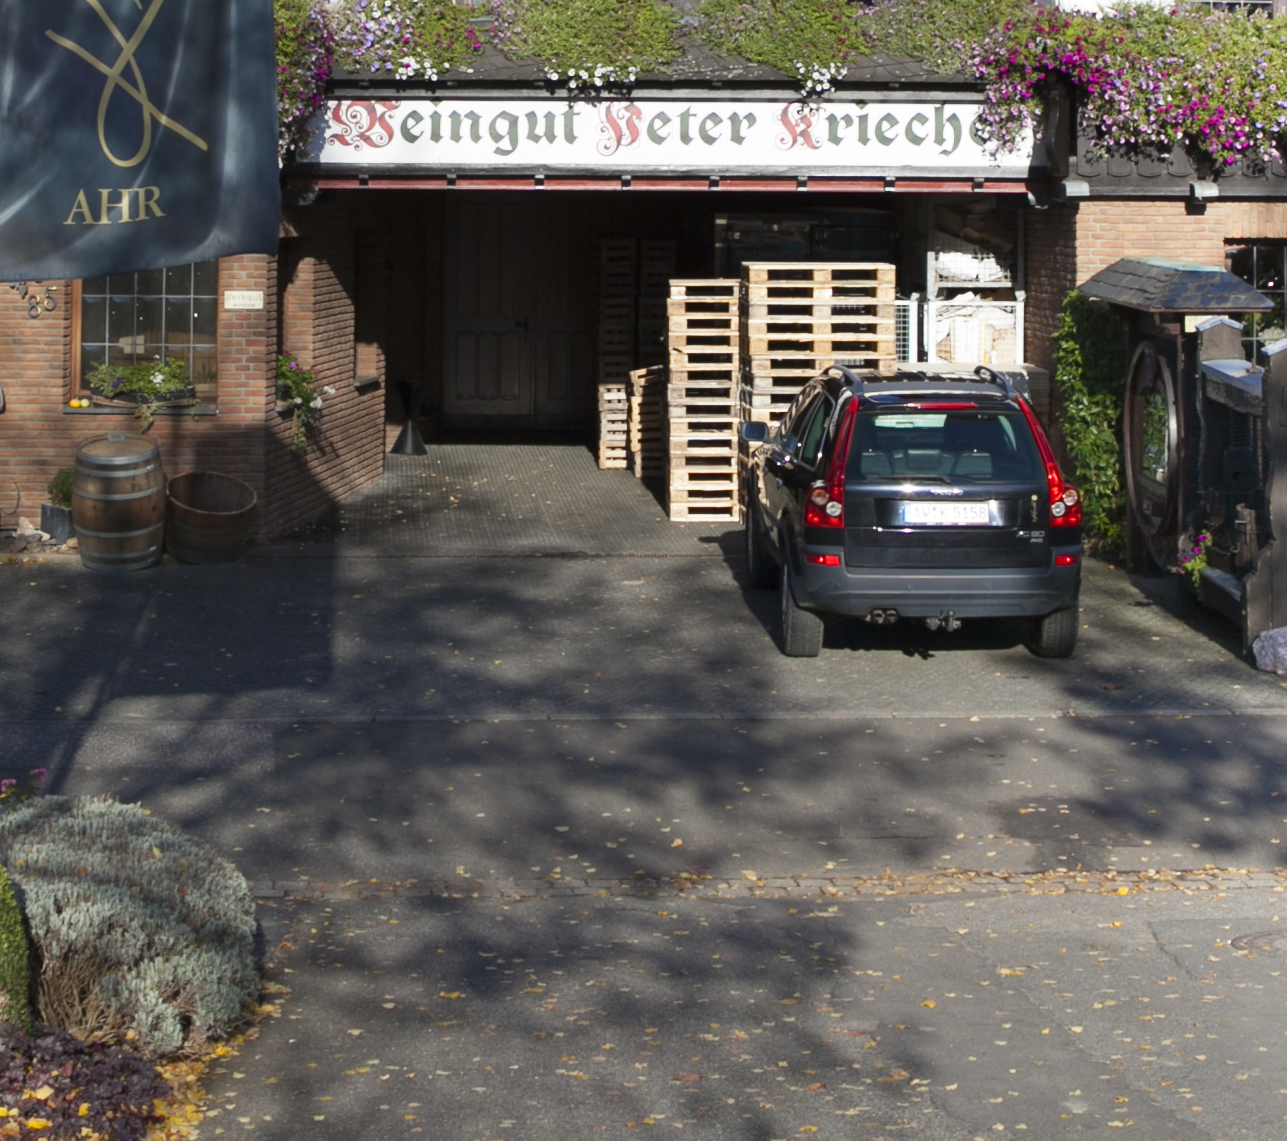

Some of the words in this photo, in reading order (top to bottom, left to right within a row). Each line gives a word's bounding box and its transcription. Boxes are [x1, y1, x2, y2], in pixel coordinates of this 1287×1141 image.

[596, 100, 758, 157] Peter
[62, 185, 167, 225] AHR
[953, 506, 987, 520] 5158
